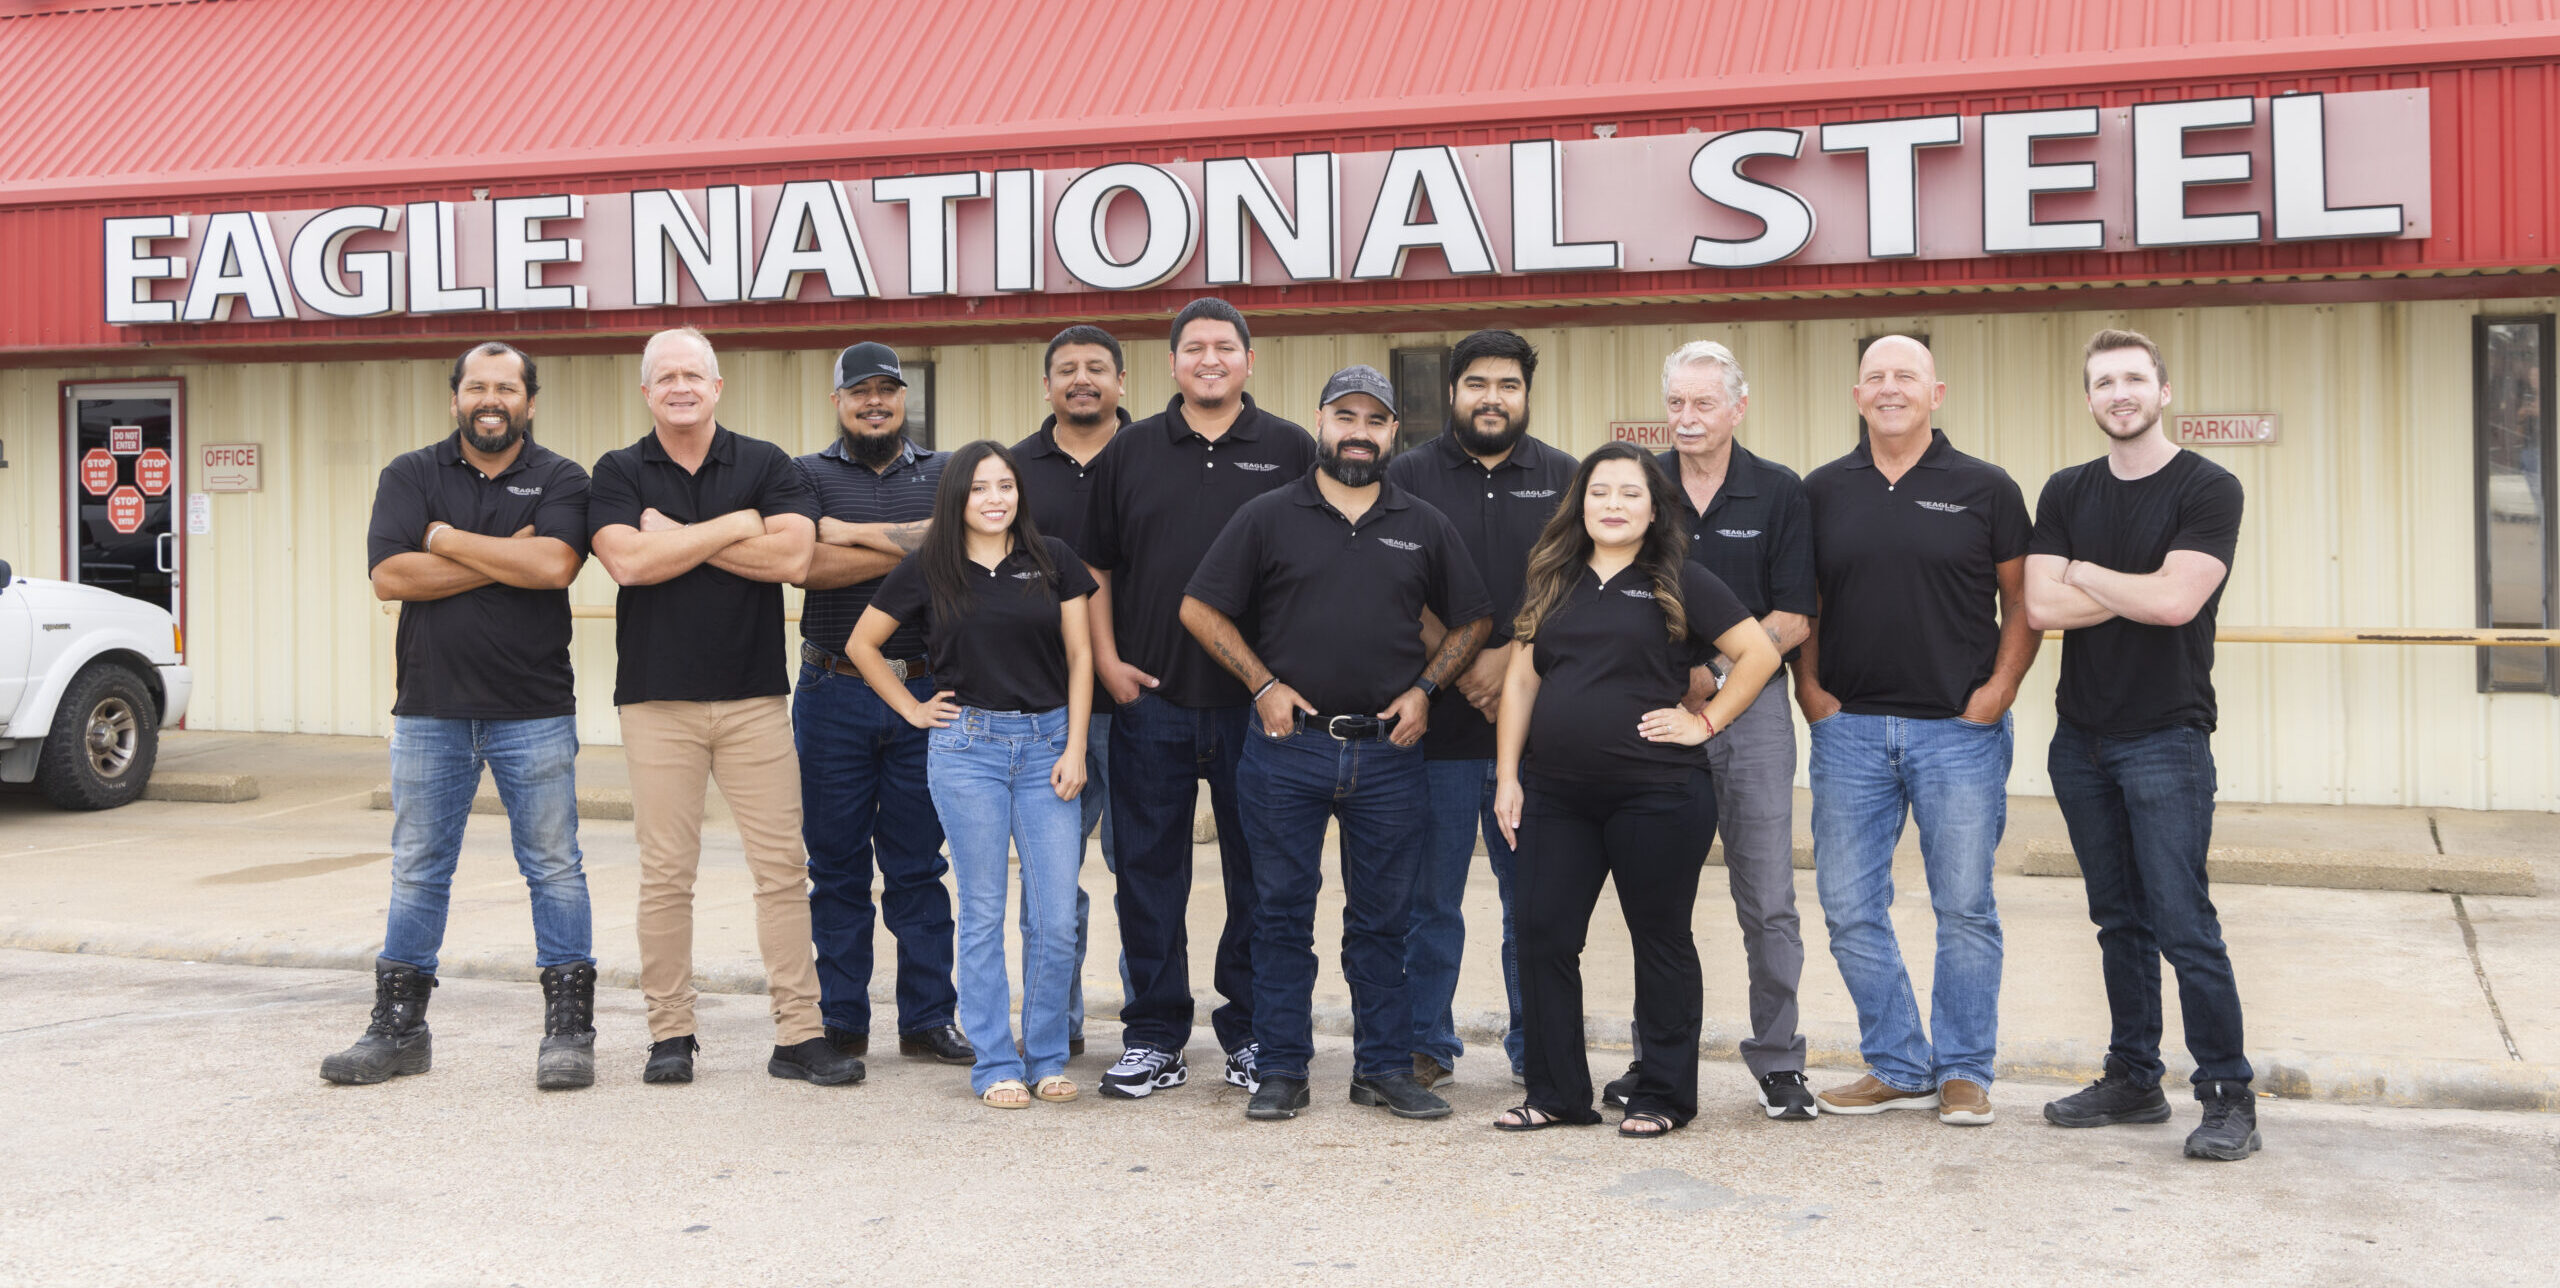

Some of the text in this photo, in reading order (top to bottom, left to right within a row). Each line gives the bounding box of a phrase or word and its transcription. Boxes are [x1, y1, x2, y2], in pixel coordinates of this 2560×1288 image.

[104, 91, 2404, 324] EAGLE NATIONAL STEEL
[2181, 419, 2270, 440] PARKING
[114, 431, 138, 440] DO NOT
[1616, 426, 1670, 445] PARKI
[115, 441, 137, 449] ENTER
[87, 458, 112, 468] STOP
[142, 459, 167, 468] STOP
[205, 450, 256, 467] OFFICE
[114, 496, 139, 506] STOP
